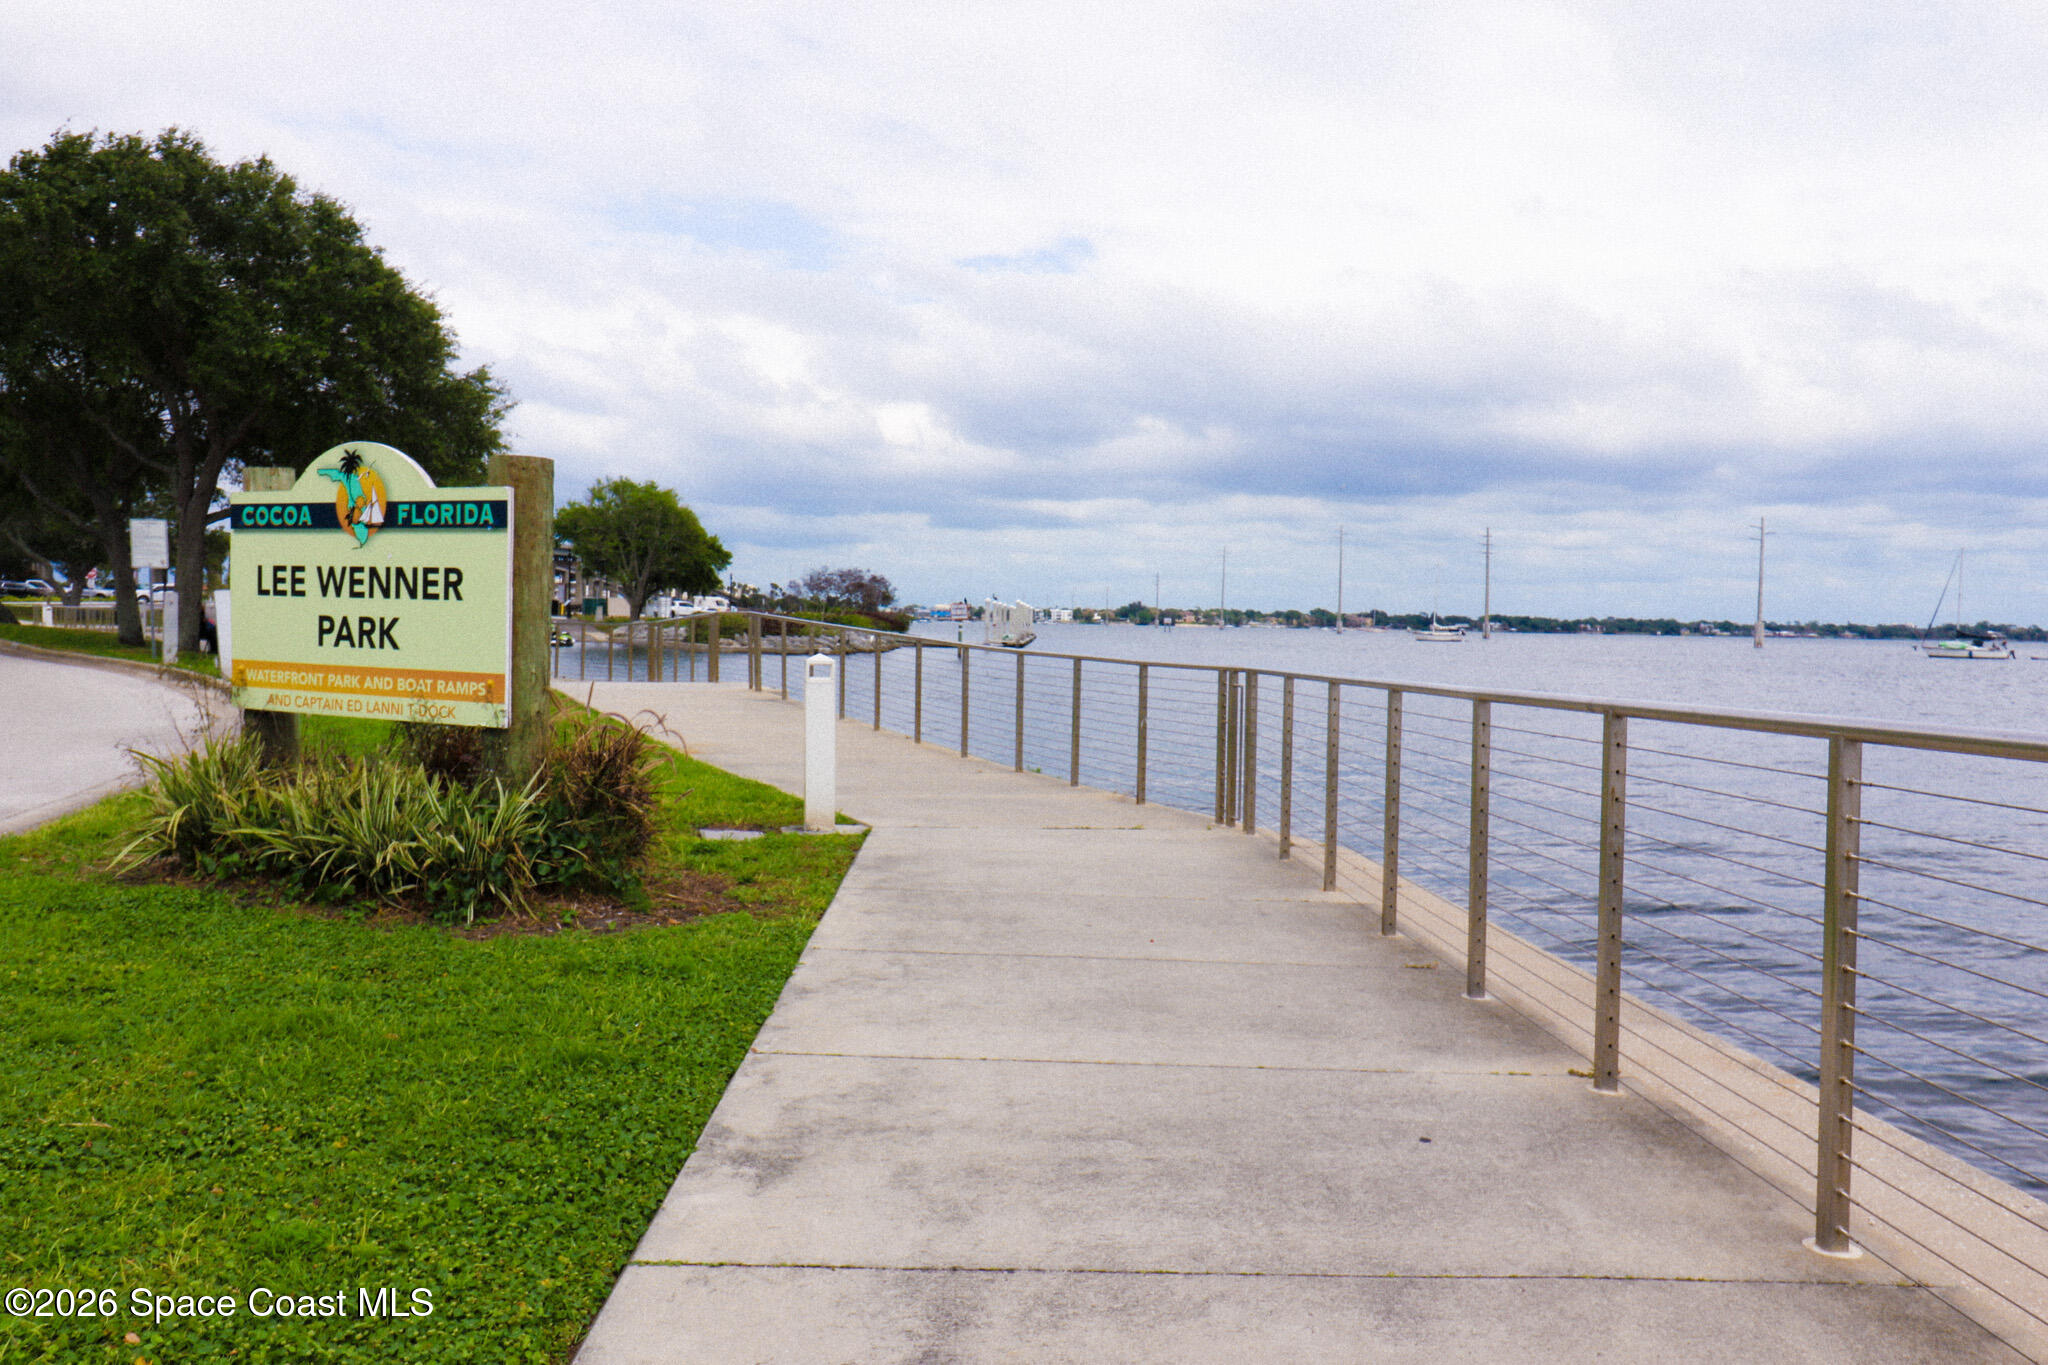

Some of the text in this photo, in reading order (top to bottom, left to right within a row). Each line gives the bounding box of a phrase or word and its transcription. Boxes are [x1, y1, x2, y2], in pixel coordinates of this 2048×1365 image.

[242, 503, 494, 526] COCOA FLORIDA
[257, 565, 463, 600] LEE WENNER
[318, 615, 400, 650] PARK
[247, 668, 486, 696] WATERFRONT PARK AND BOAT RAMPS
[267, 693, 292, 707] AND
[295, 695, 342, 711] CAPTAIN
[347, 699, 363, 712] ED
[366, 701, 403, 715] LANNI
